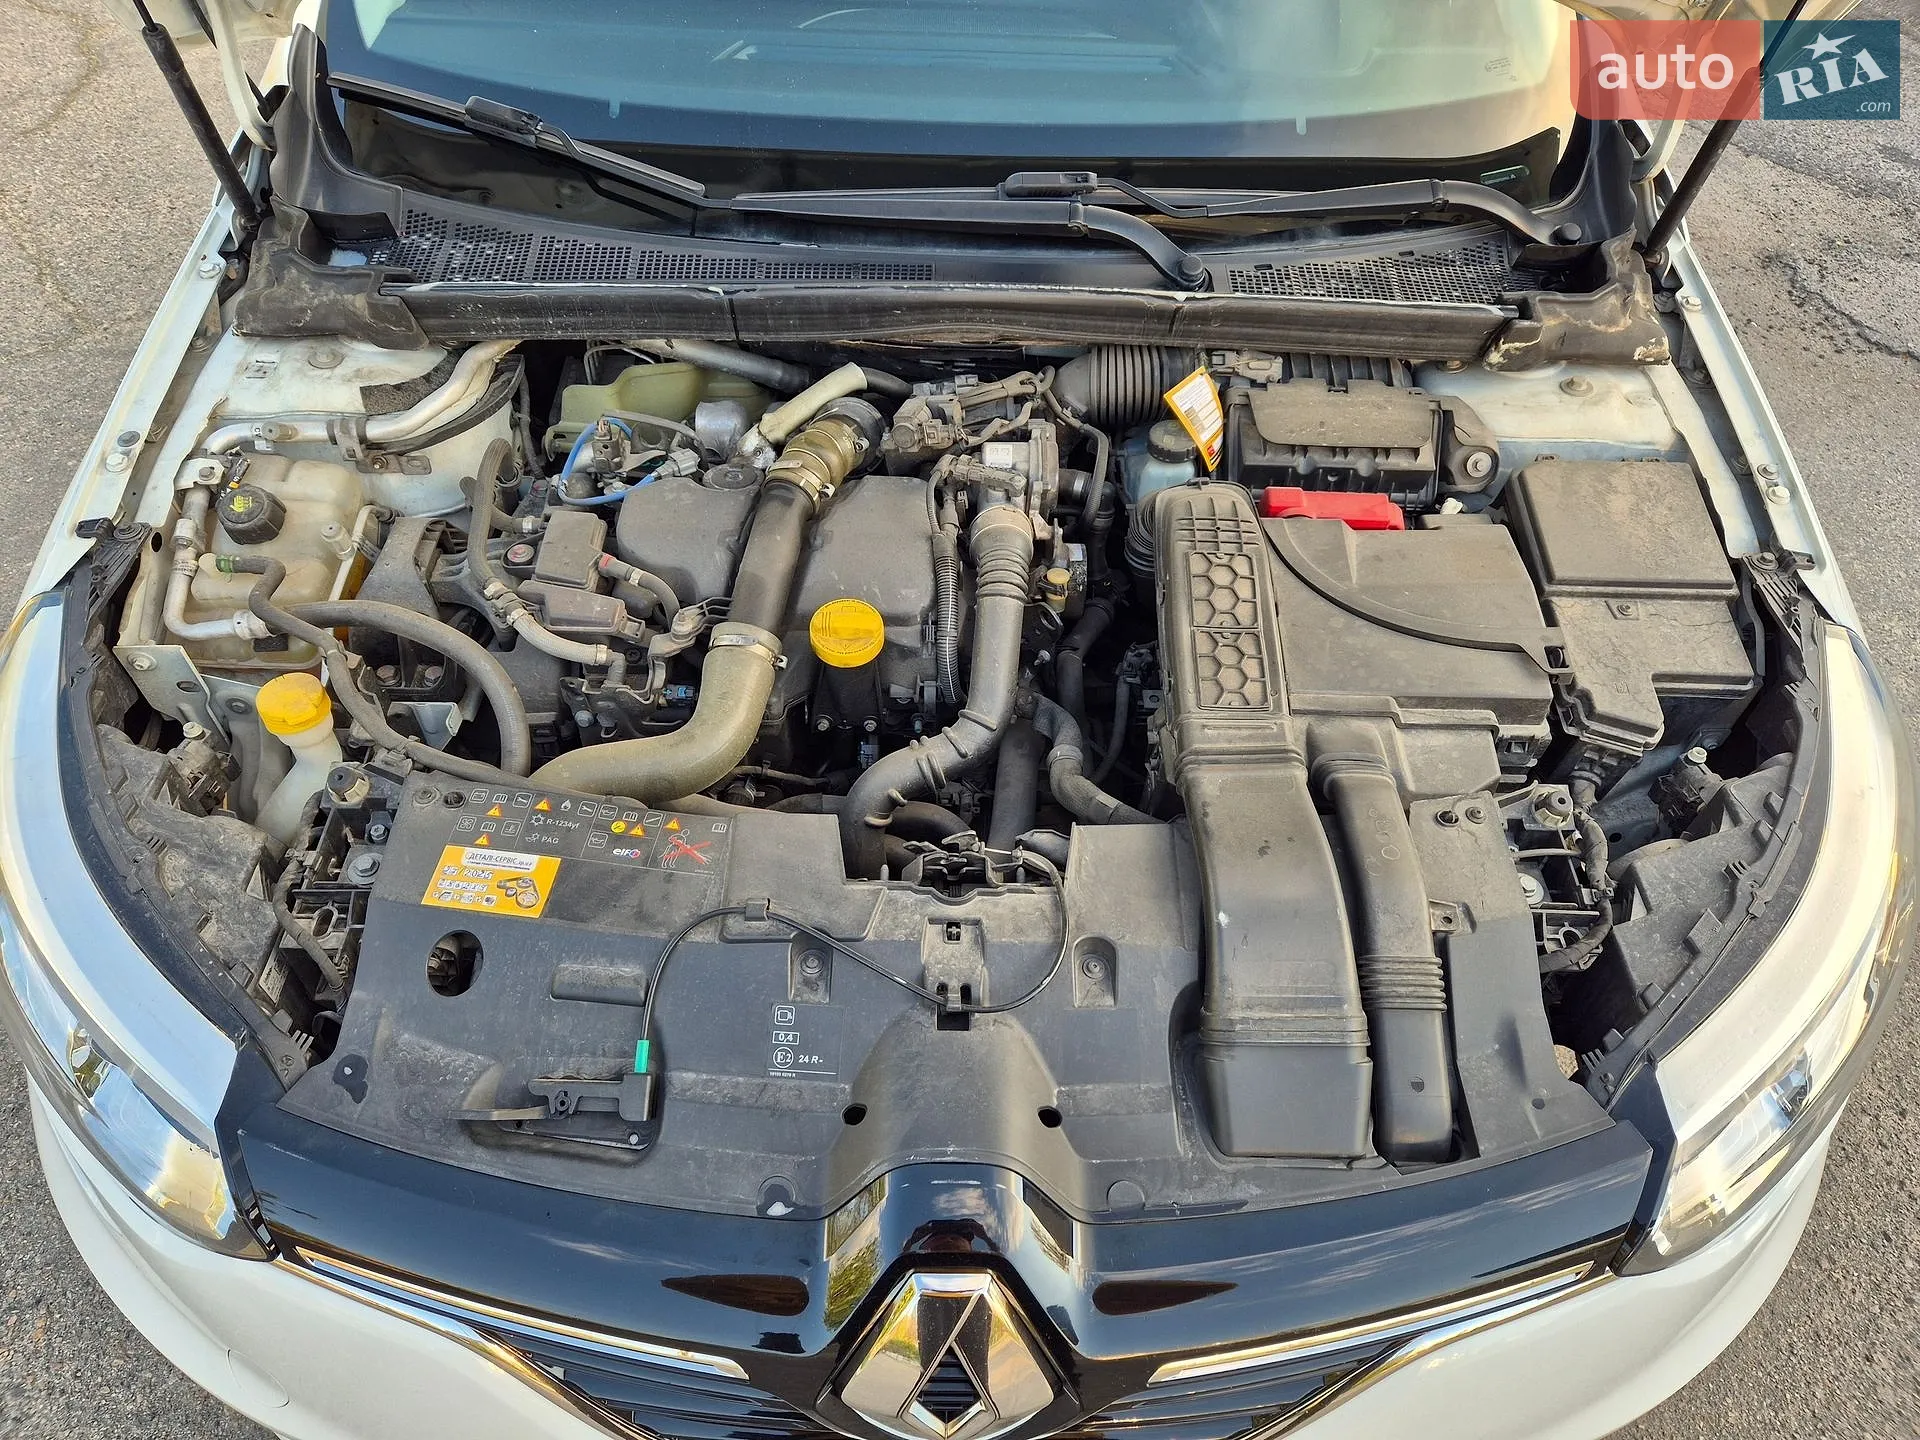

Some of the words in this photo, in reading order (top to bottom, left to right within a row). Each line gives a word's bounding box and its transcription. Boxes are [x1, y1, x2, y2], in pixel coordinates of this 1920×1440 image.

[546, 818, 580, 830] R-1234yf
[541, 836, 560, 844] PAG
[776, 1051, 792, 1063] E2
